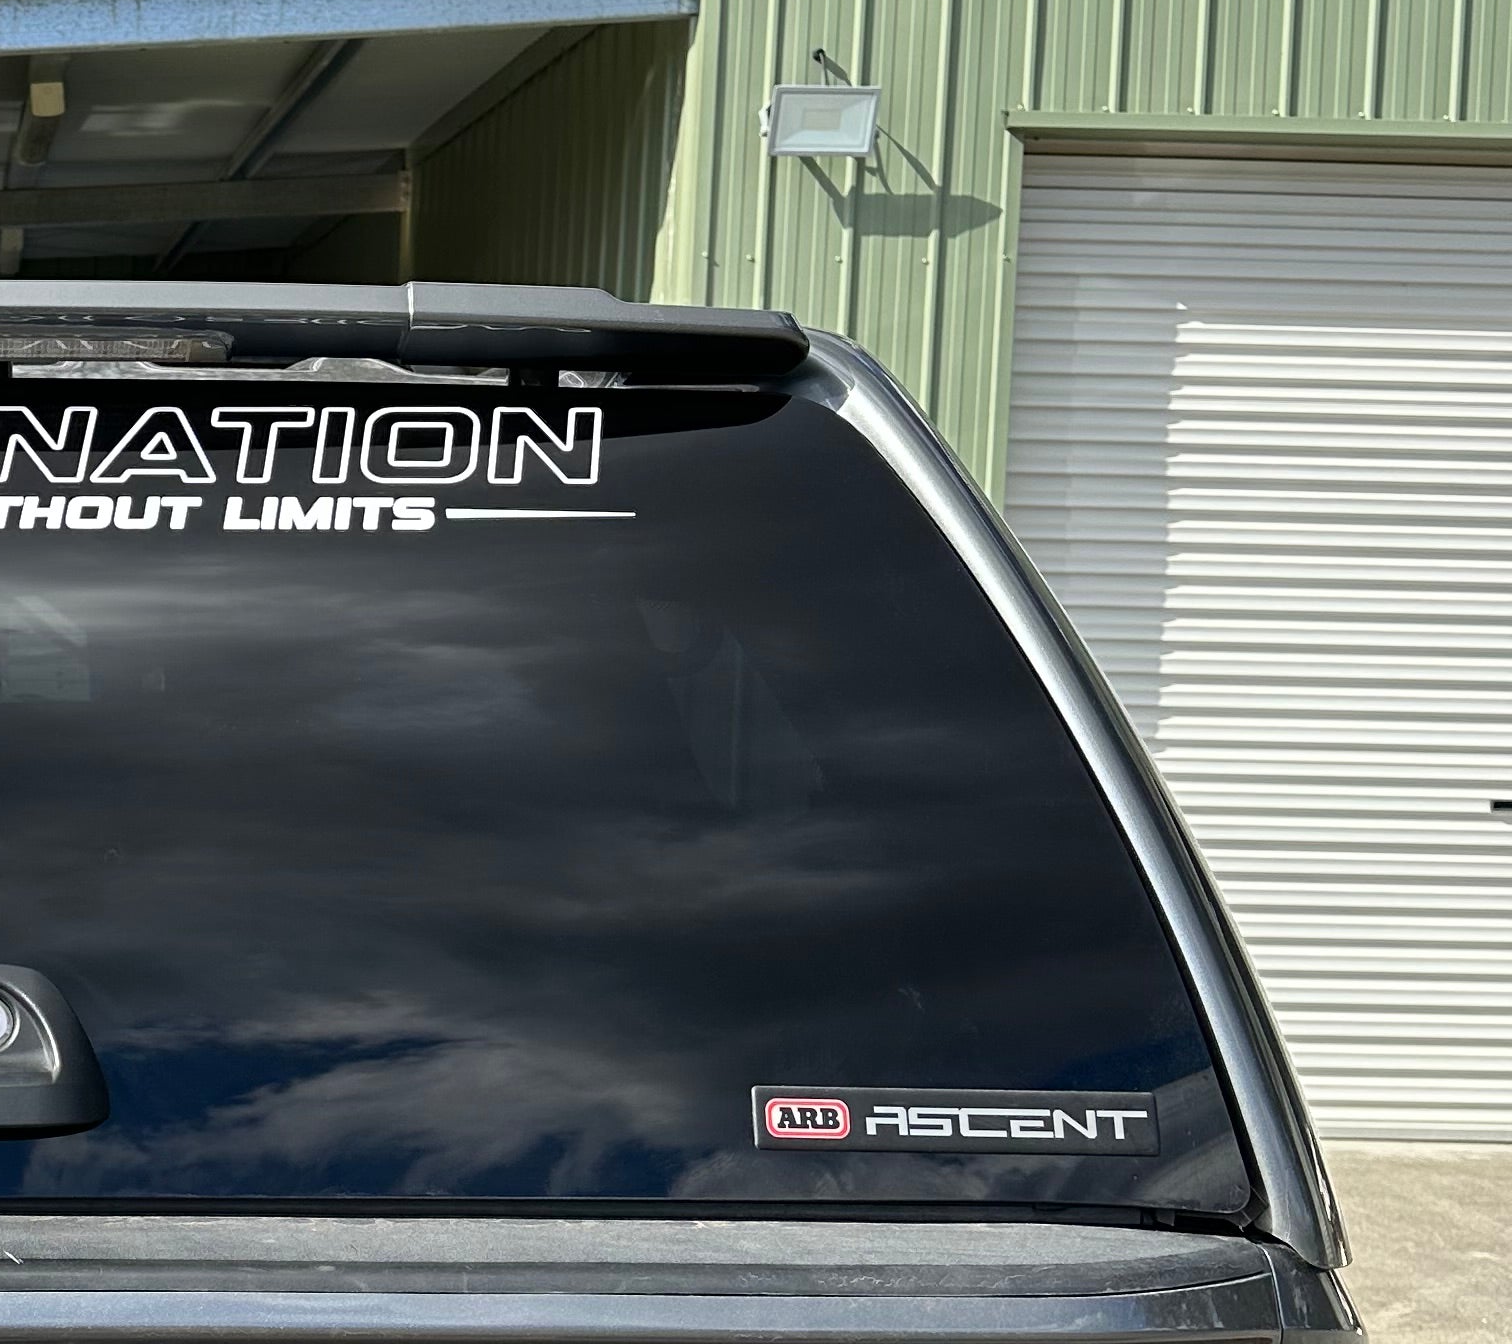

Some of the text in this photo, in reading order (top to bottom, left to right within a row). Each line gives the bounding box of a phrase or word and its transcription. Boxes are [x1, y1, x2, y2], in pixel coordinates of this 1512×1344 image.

[223, 495, 436, 531] LIMITS
[777, 1105, 1148, 1140] ARB ASCENT
